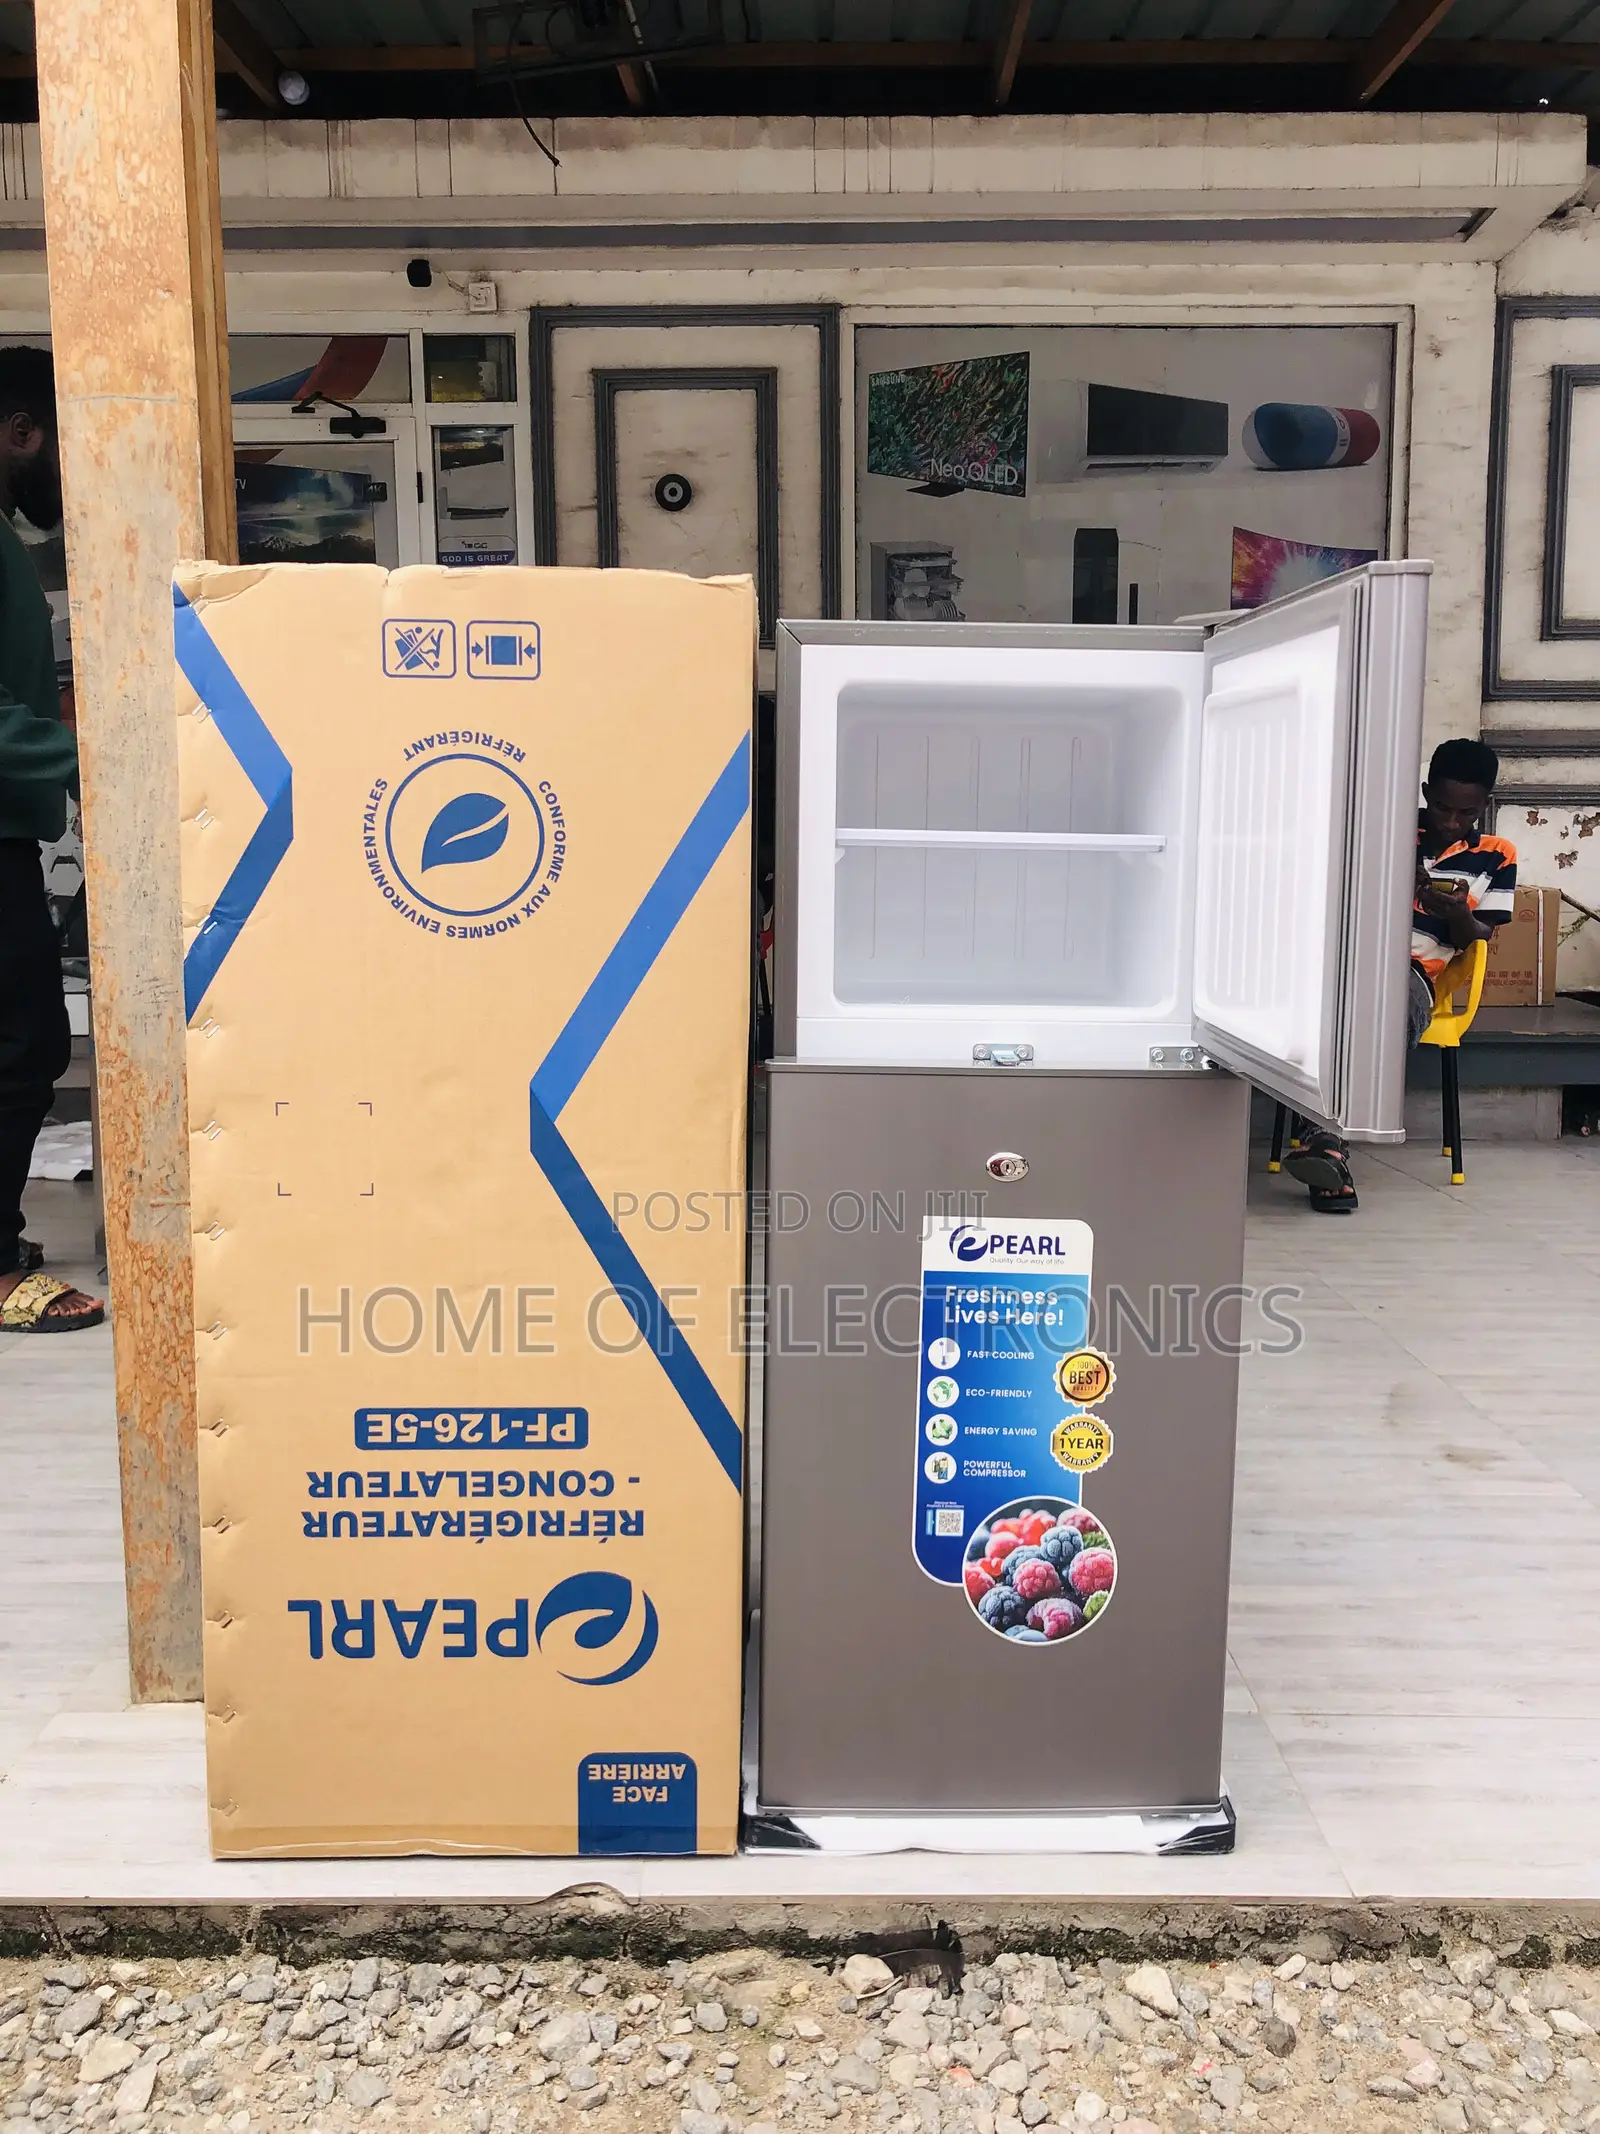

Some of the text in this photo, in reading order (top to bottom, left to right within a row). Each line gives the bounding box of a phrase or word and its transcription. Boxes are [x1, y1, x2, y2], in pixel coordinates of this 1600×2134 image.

[931, 458, 1018, 486] Neo QLED
[441, 555, 462, 563] GOD
[477, 554, 509, 562] GREAT
[403, 730, 527, 764] RÉFRIGÉRANT
[363, 778, 567, 939] CONFORME AUX NORMES ENVIRONMENTALES
[989, 1234, 1066, 1256] PEARL
[945, 1285, 1058, 1306] Freshness
[944, 1305, 1064, 1326] Lives Here!
[967, 1350, 1035, 1360] FAST COOLING
[1069, 1370, 1101, 1385] BEST
[965, 1388, 1033, 1398] ECO-FRIENDLY
[366, 1413, 575, 1444] PF-126-5E
[964, 1426, 1038, 1437] ENERGY SAVING
[1063, 1421, 1101, 1436] WARRANTY
[1060, 1438, 1104, 1449] 1 YEAR
[963, 1460, 1012, 1469] POWERFUL
[1062, 1451, 1100, 1466] WARRANTY
[963, 1468, 1027, 1478] COMPRESSOR
[306, 1469, 615, 1499] CONGELATEUR
[301, 1509, 645, 1544] RÉFRIGÉRATEUR
[287, 1598, 530, 1660] PEARL
[587, 1763, 687, 1784] ARRIÈRE
[612, 1786, 669, 1803] FACE
